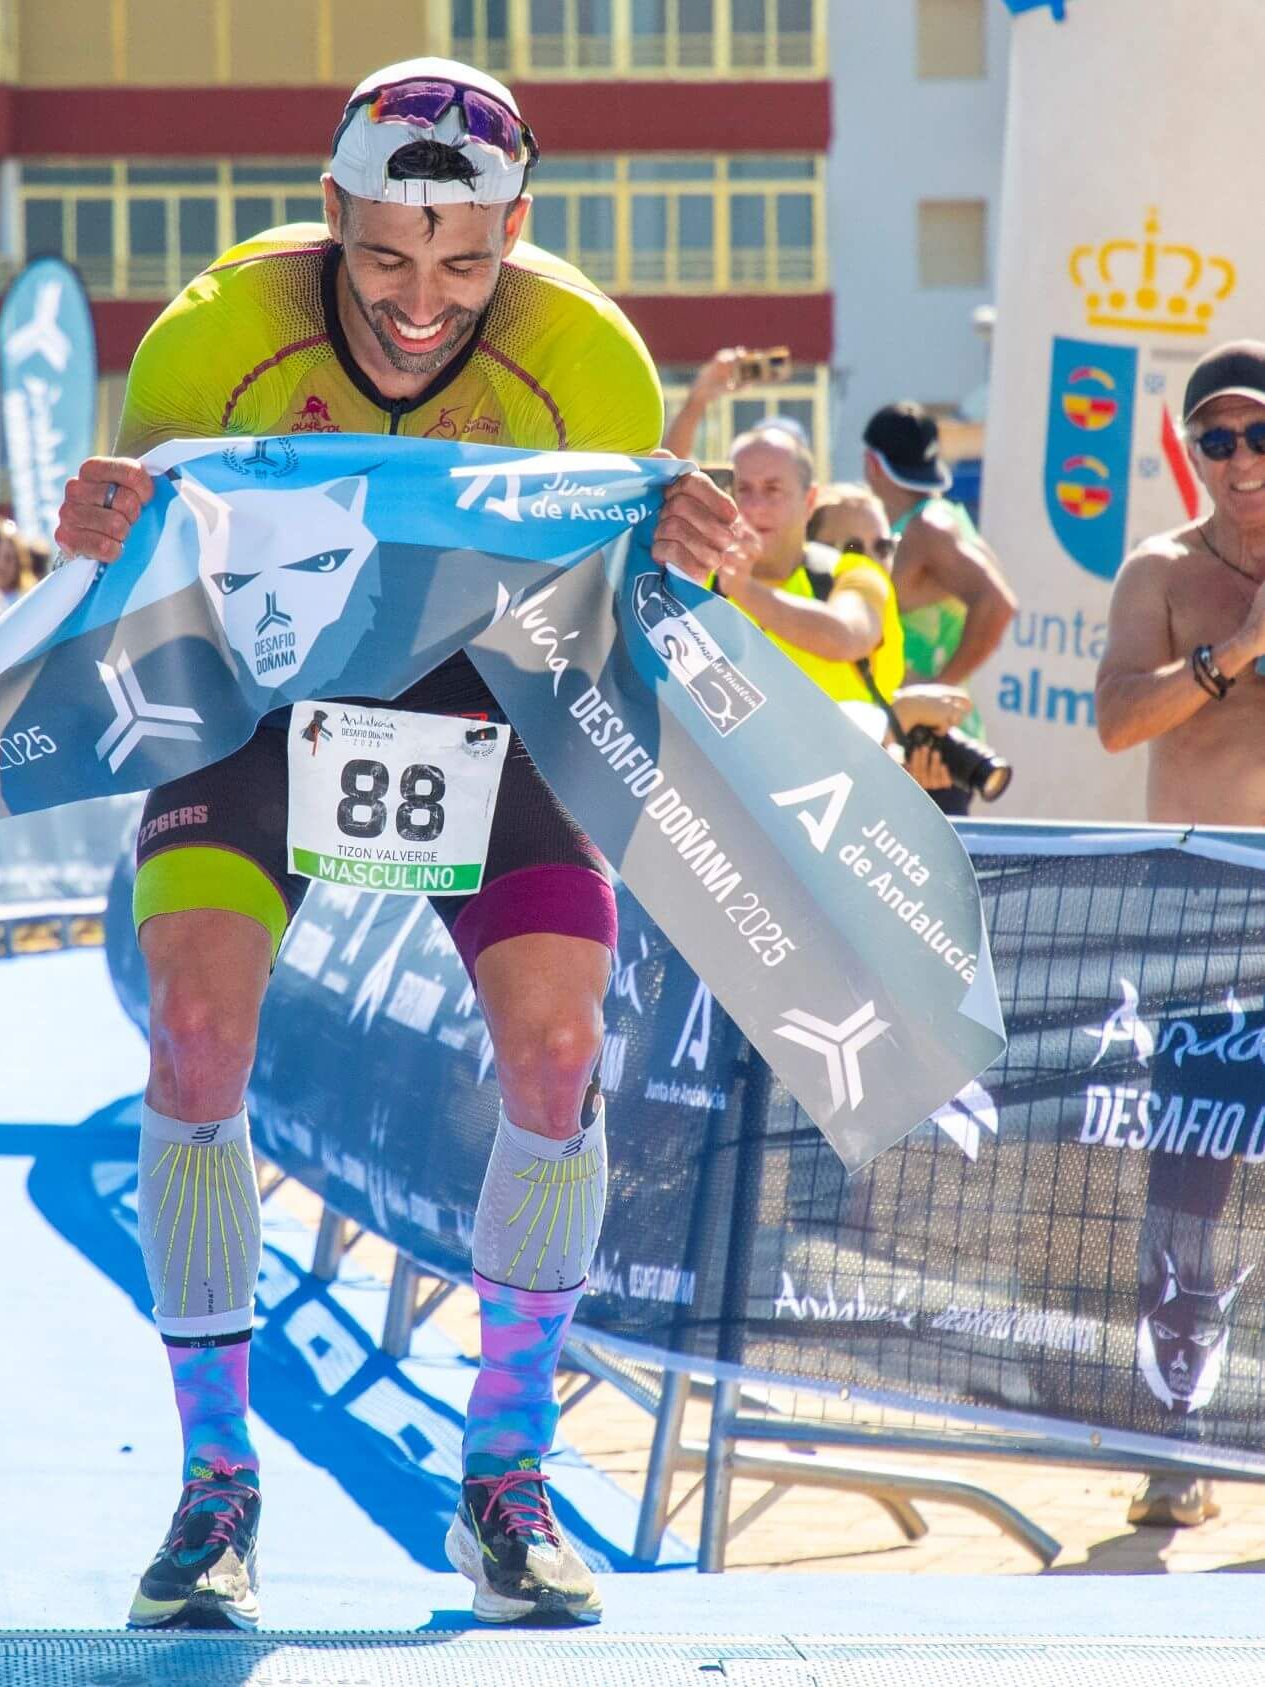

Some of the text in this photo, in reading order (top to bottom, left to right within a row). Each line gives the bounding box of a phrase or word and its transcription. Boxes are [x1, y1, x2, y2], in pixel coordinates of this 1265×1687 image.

[531, 496, 653, 523] de Andal
[254, 632, 296, 657] DESAFIO
[256, 650, 297, 676] DOÑANA
[341, 727, 367, 738] DESAFIO
[336, 758, 446, 842] 88
[139, 804, 208, 848] 226ERS
[568, 685, 664, 798] DESAFIO
[645, 787, 743, 903] DOÑANA
[724, 892, 797, 968] 2025
[337, 843, 439, 863] TIZON VALVERDE
[862, 819, 931, 888] Junta
[318, 856, 455, 890] MASCULINO
[838, 844, 980, 985] de Andalucía
[1079, 1084, 1247, 1161] DESAFIO
